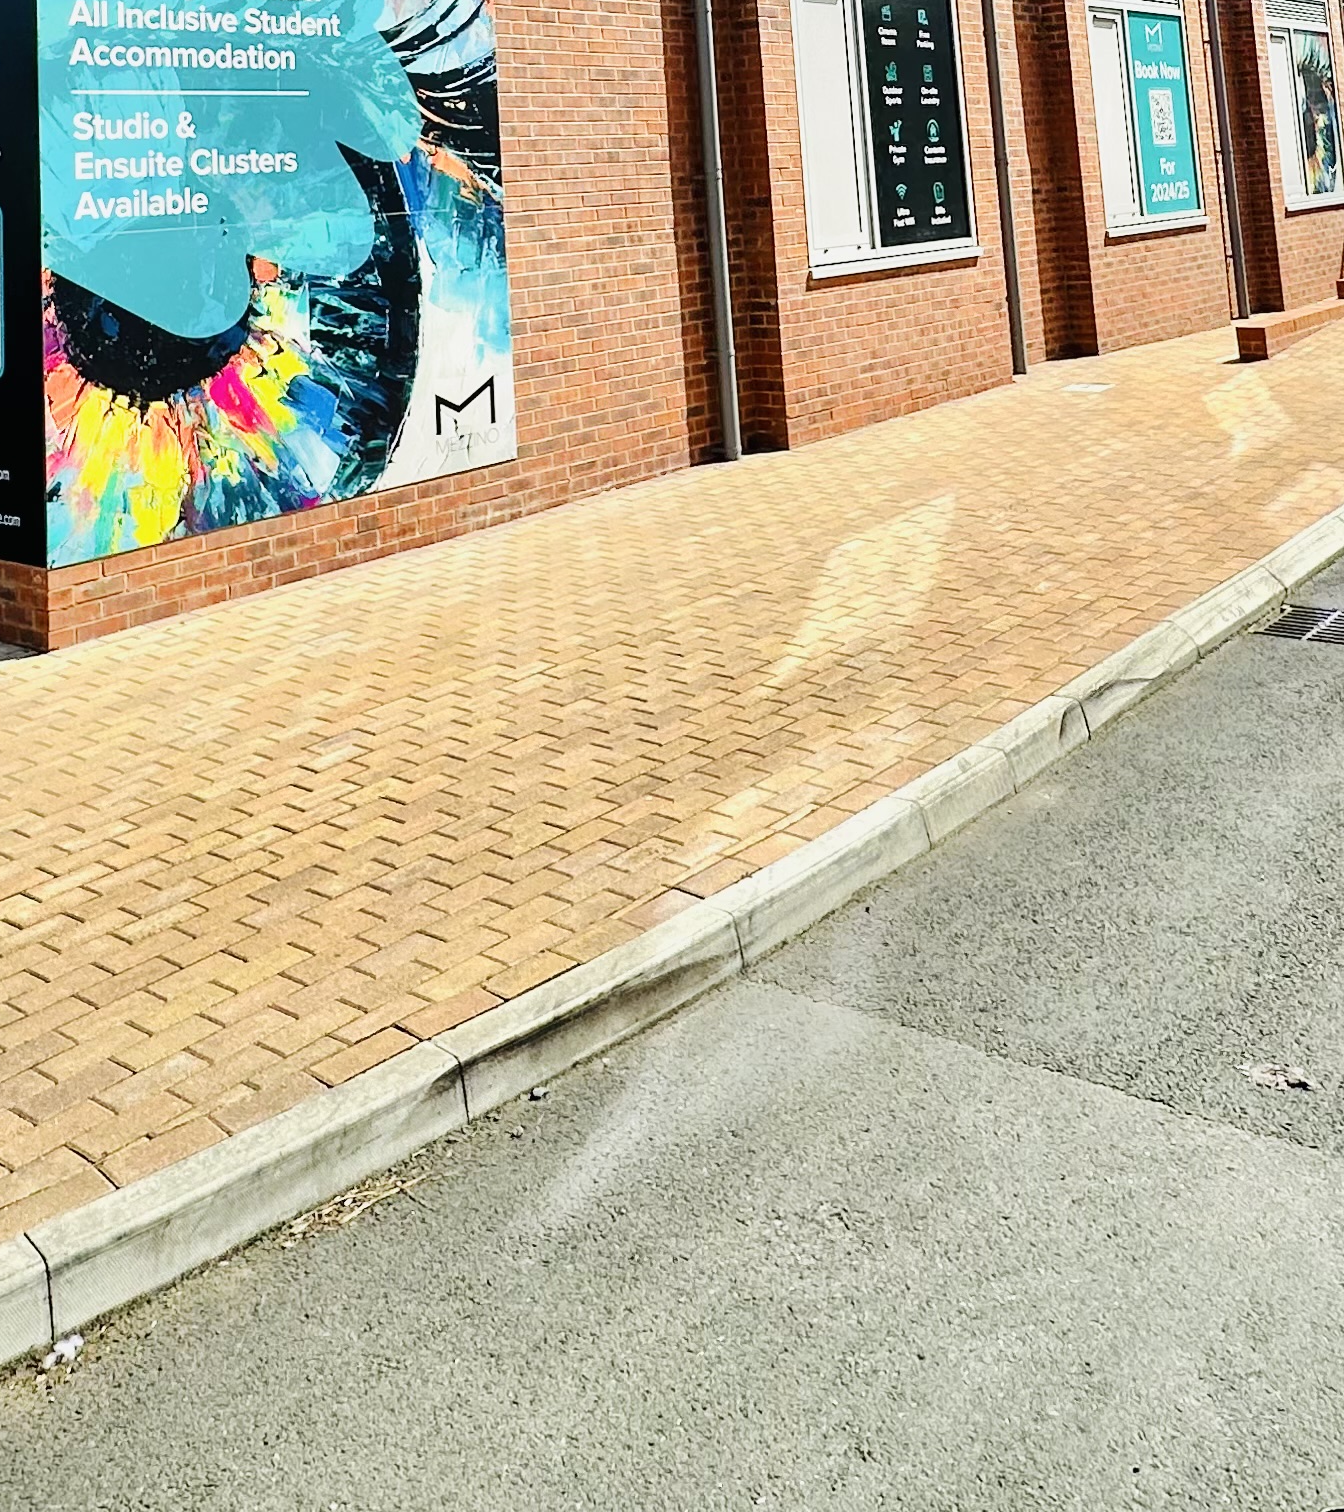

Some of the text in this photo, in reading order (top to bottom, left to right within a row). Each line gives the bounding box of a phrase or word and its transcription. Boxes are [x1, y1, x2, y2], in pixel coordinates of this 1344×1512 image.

[68, 0, 342, 37] All Inclusive Student
[68, 38, 296, 70] Accommodation
[1134, 59, 1181, 80] Book Now
[73, 111, 197, 140] Studio &
[74, 148, 298, 180] Ensuite Clusters
[1159, 157, 1176, 176] For
[74, 186, 209, 220] Available
[1150, 180, 1190, 203] 2024/25
